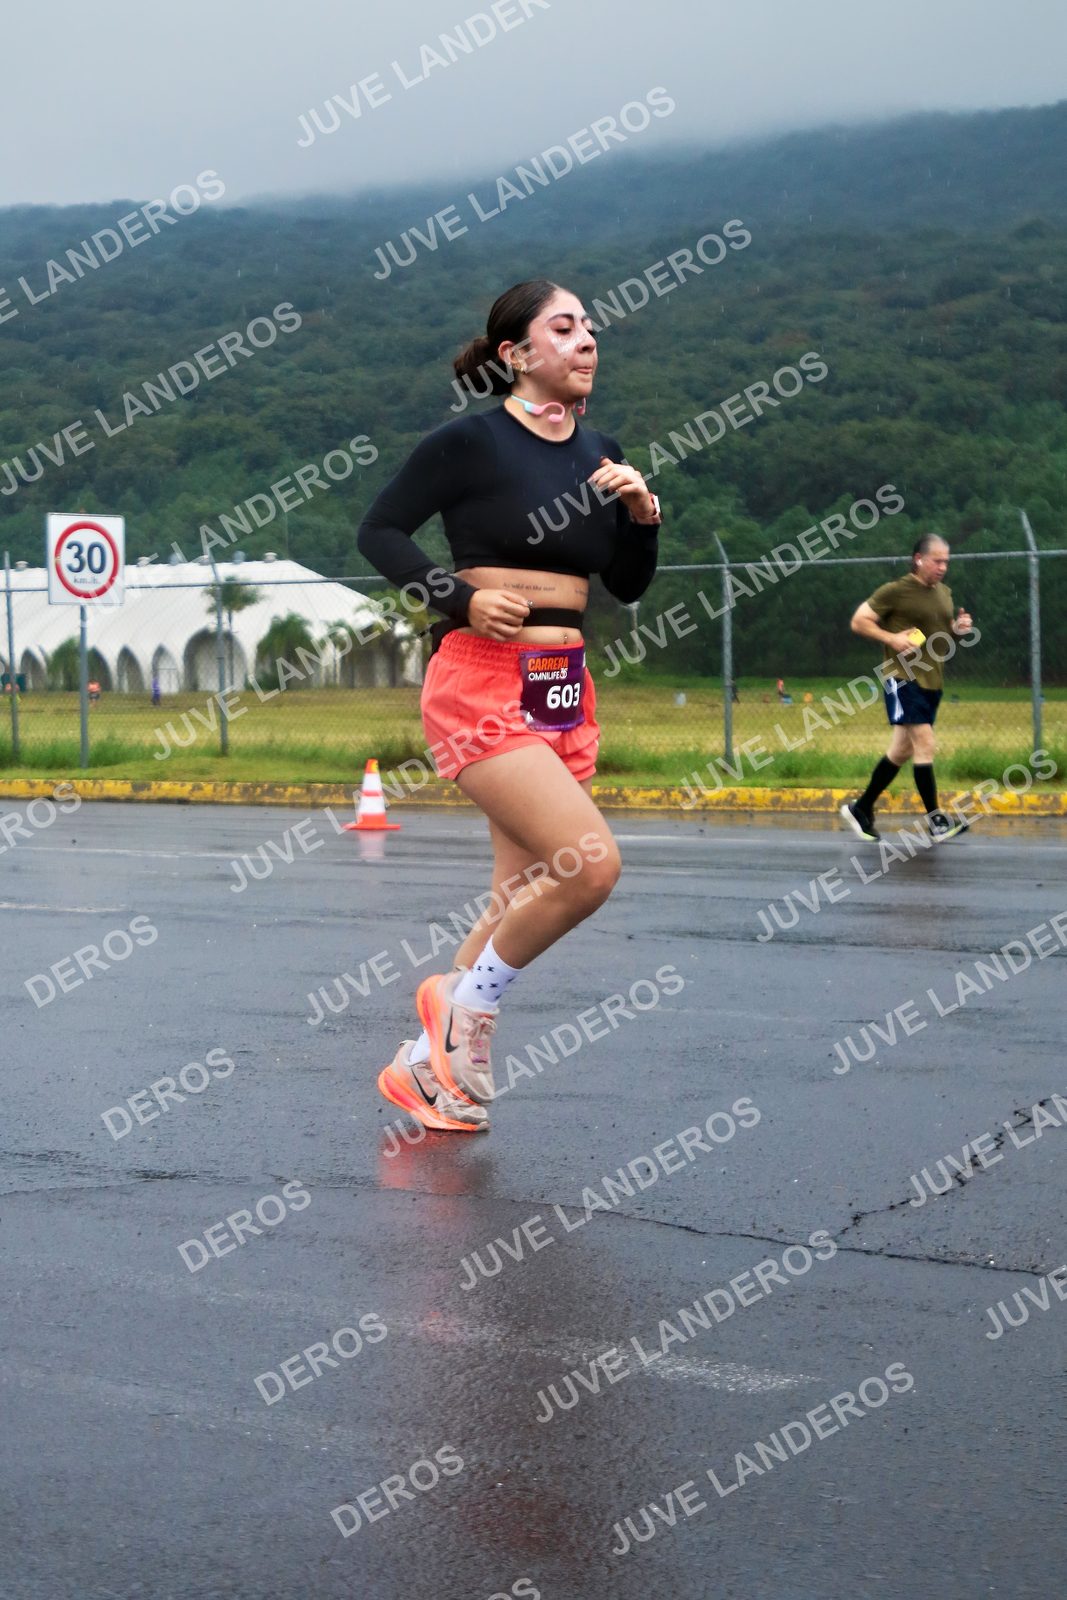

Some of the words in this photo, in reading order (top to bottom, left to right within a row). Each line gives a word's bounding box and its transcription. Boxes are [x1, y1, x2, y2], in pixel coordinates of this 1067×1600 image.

[66, 540, 107, 574] 30
[527, 656, 569, 672] CARRERA
[528, 670, 560, 681] OMNILIFE
[546, 682, 580, 709] 603
